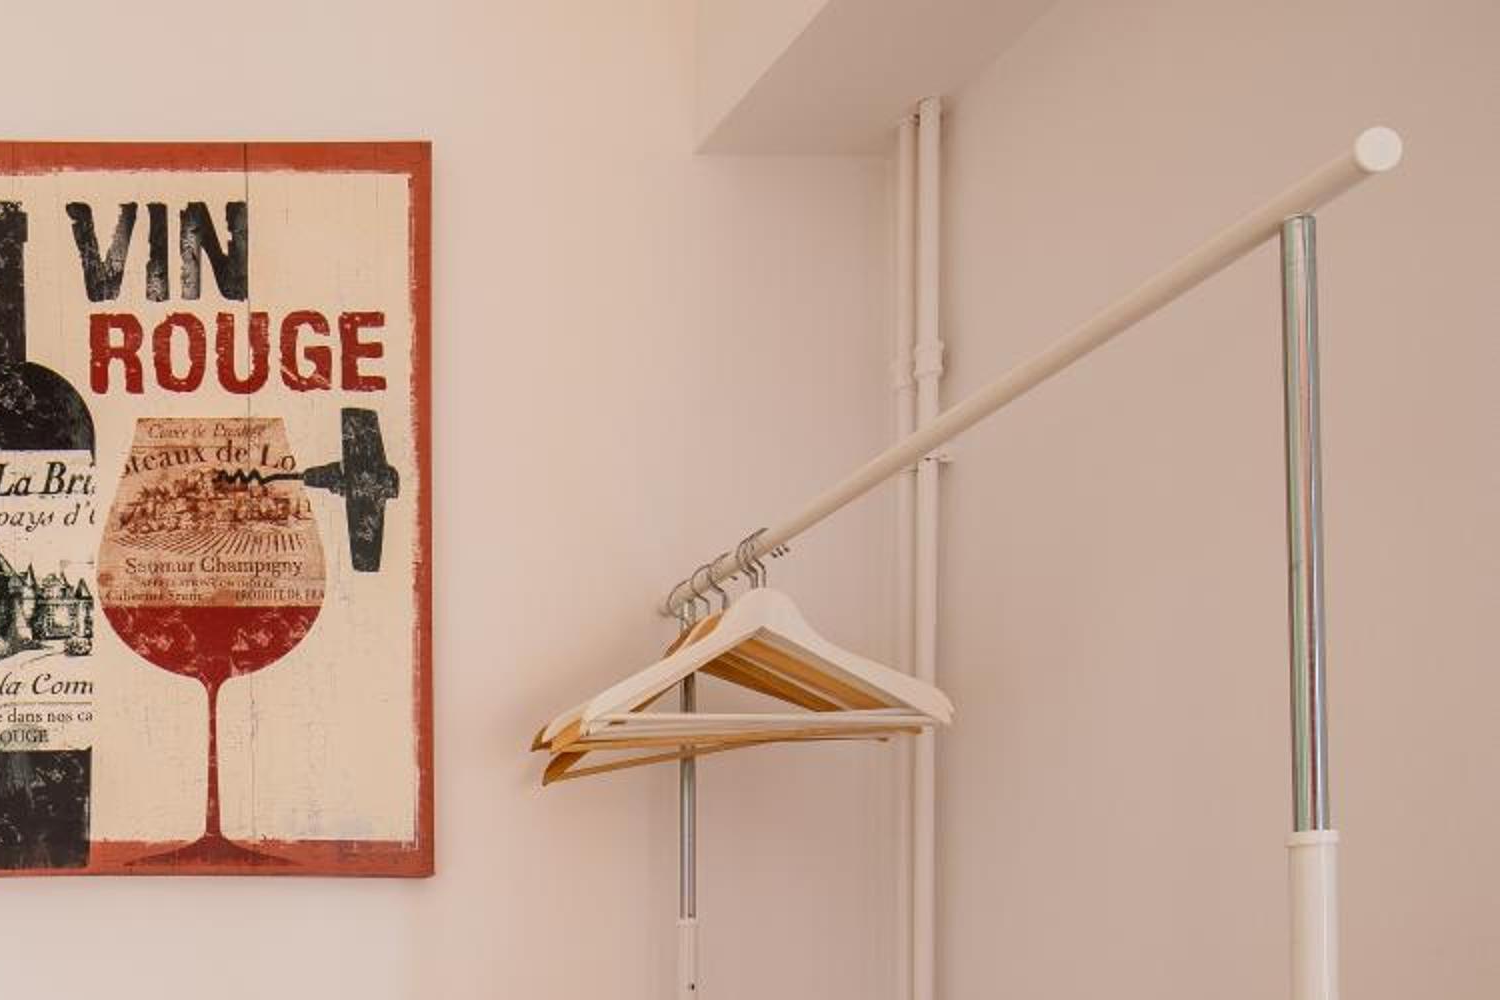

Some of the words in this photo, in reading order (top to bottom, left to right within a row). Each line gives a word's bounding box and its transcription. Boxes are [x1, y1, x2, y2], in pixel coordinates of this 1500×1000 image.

[65, 201, 248, 302] VIN
[88, 311, 387, 394] ROUGE
[215, 440, 248, 463] de
[260, 444, 297, 471] Lo
[200, 556, 304, 577] Champigny
[0, 672, 22, 696] la
[7, 708, 43, 723] dans
[47, 712, 73, 723] nos
[77, 712, 94, 722] ca
